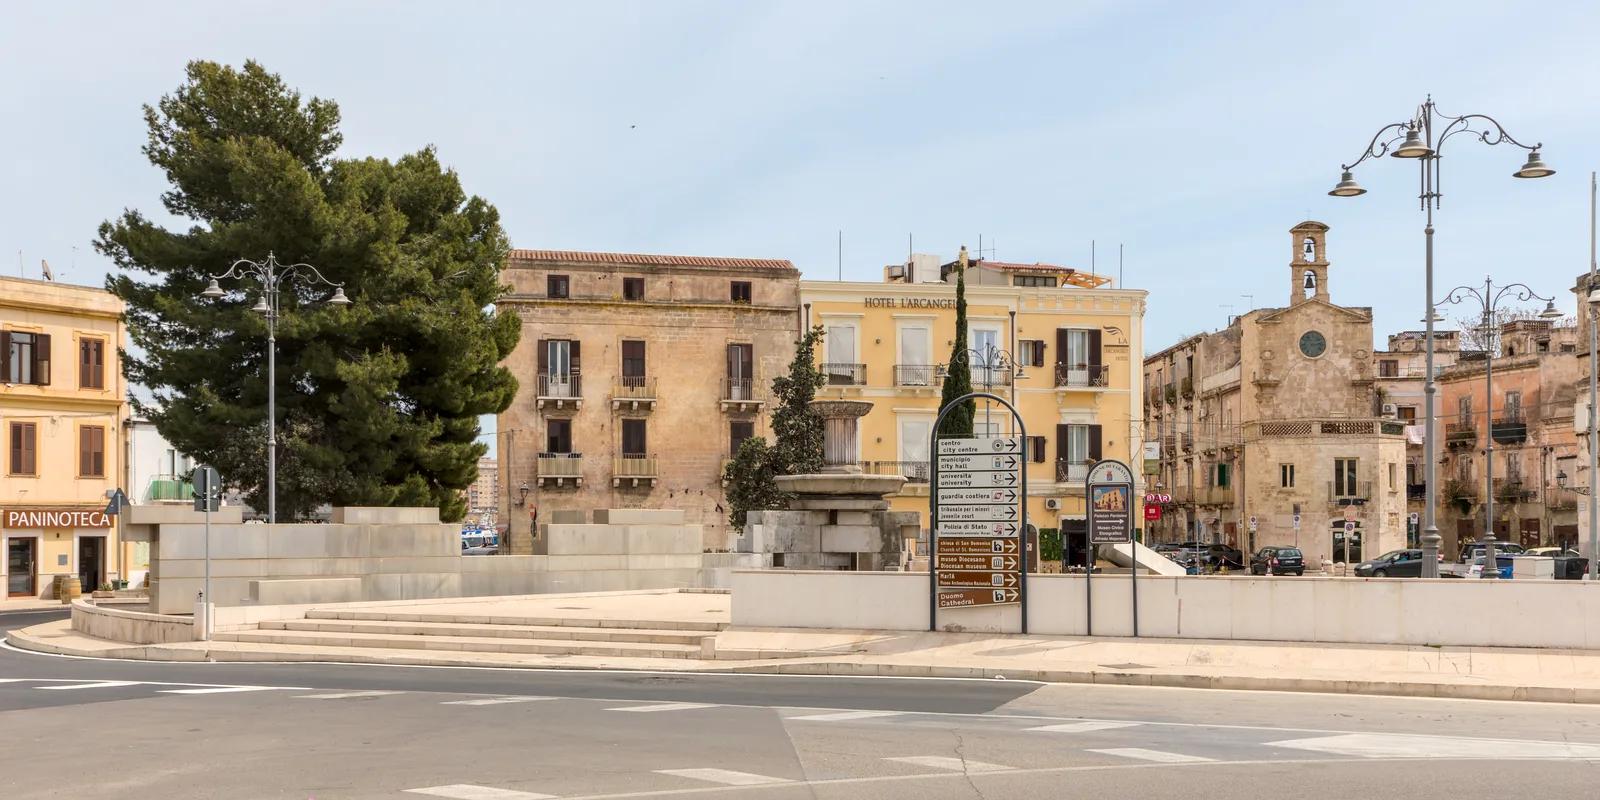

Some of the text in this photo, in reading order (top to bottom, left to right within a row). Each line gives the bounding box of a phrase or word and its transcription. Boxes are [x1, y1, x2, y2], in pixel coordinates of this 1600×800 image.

[864, 298, 958, 309] HOTEL L'ARCANGEL
[9, 512, 110, 526] PANINOTECA
